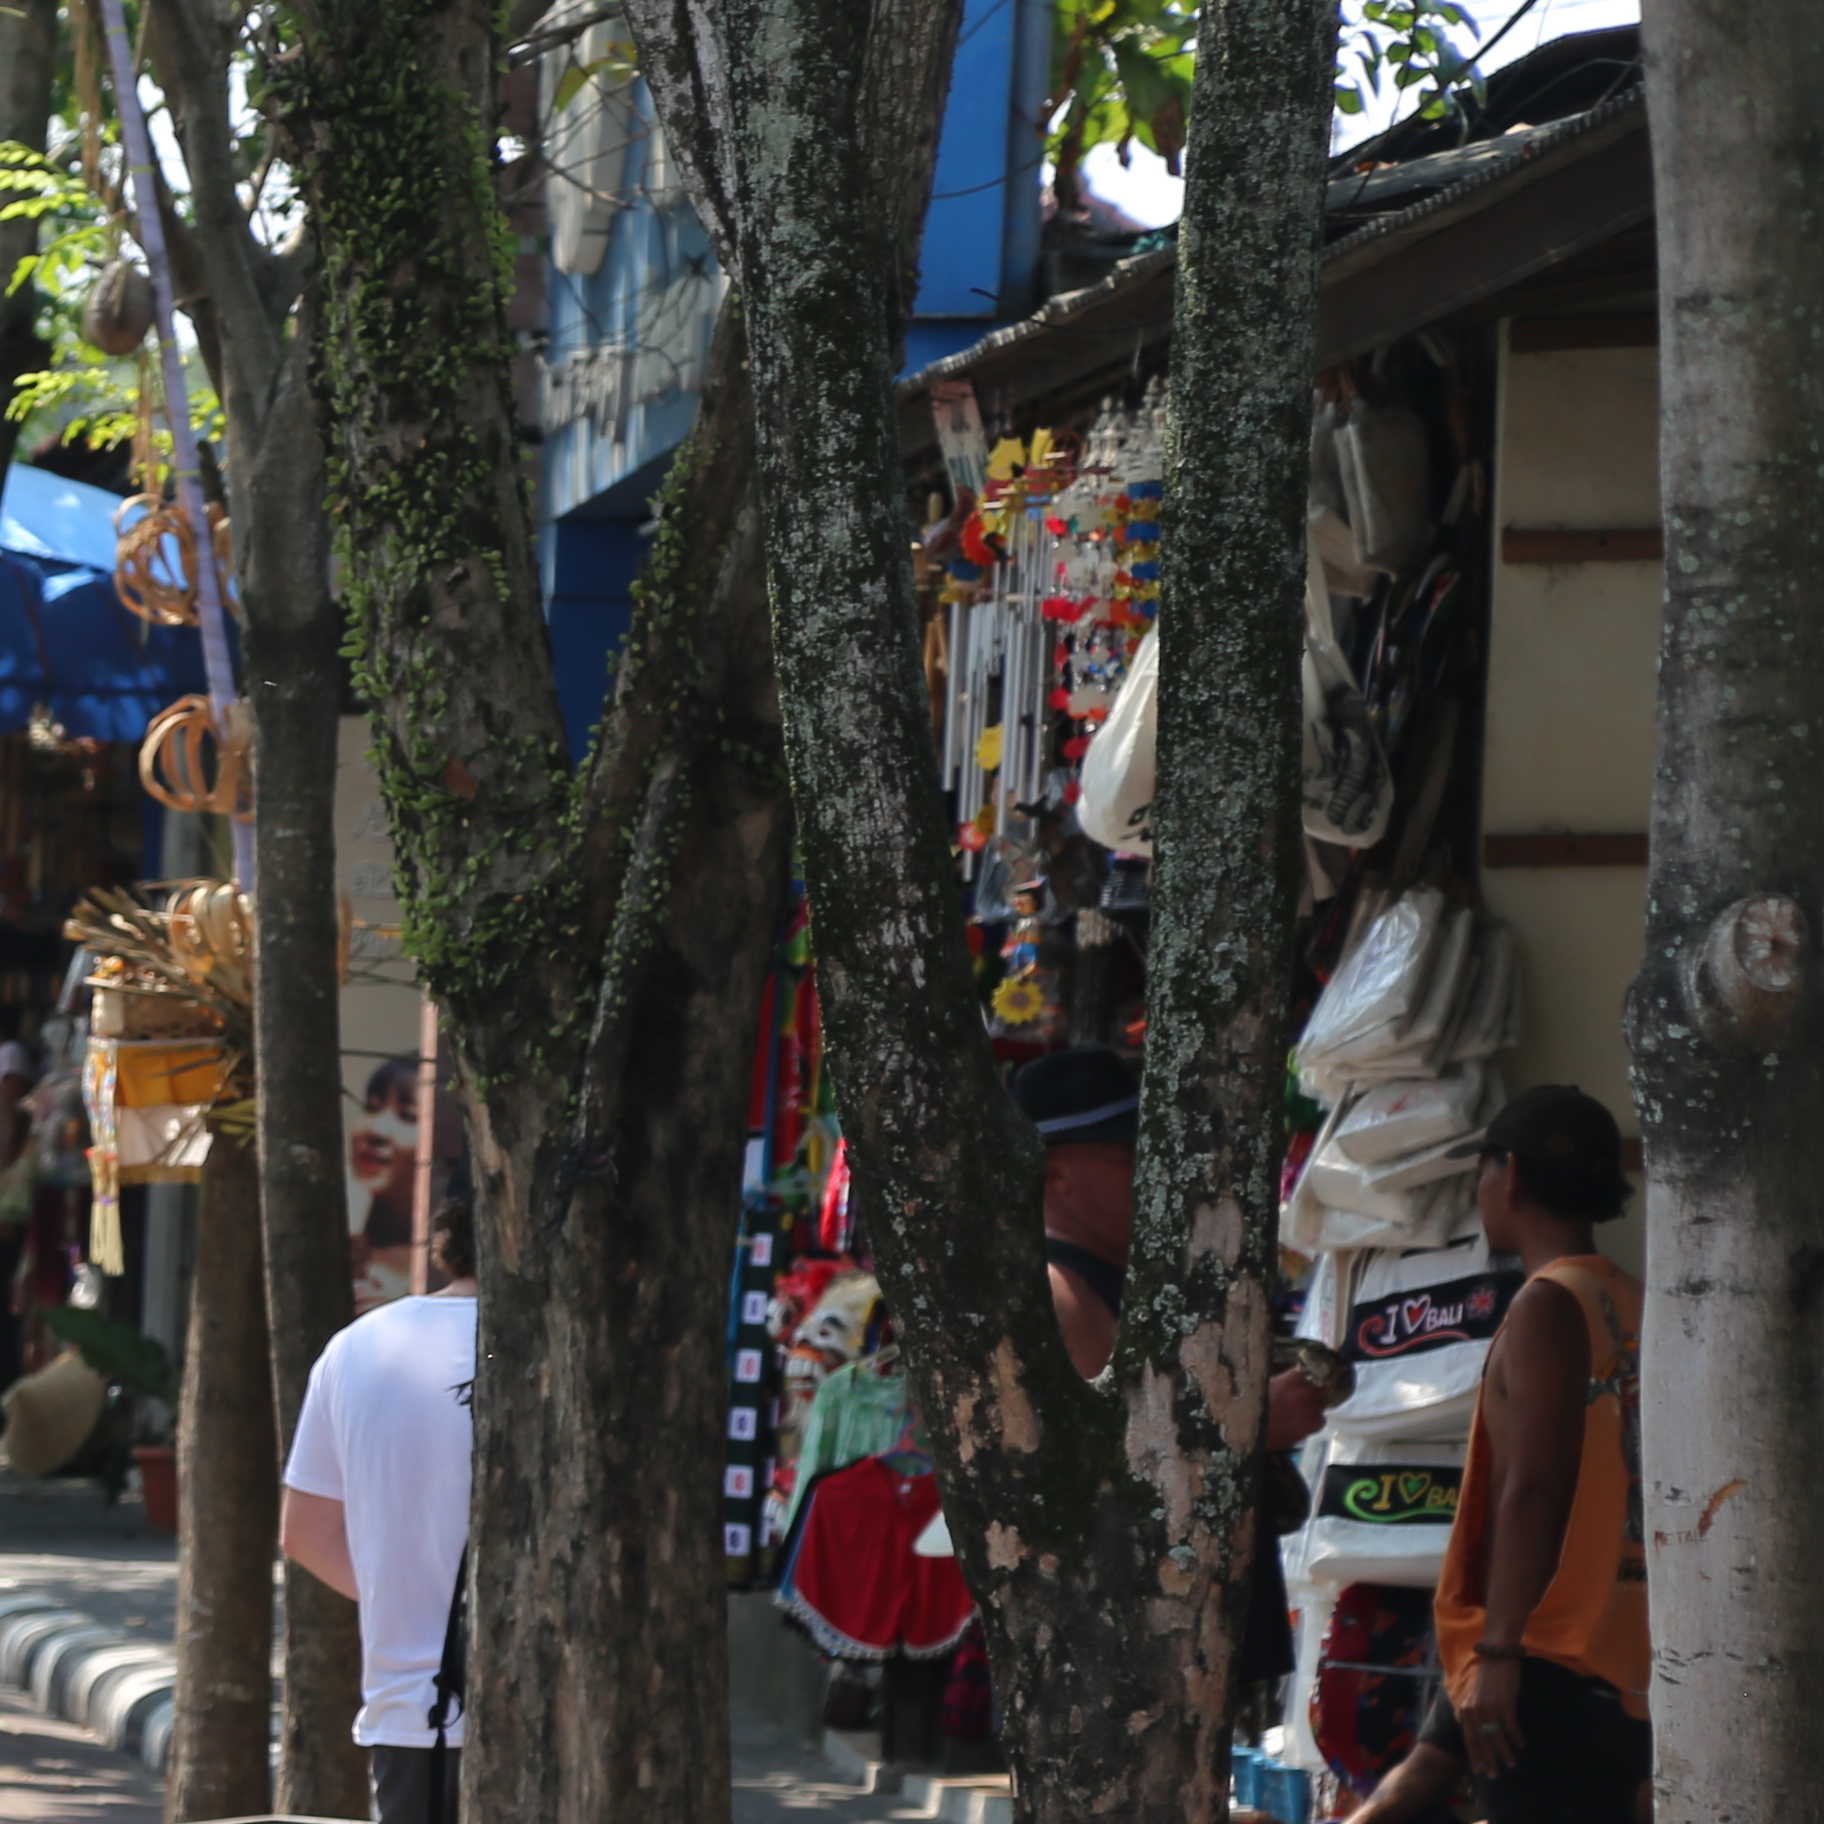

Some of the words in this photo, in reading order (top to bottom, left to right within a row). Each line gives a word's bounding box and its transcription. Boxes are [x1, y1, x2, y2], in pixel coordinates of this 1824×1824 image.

[1379, 1305, 1399, 1344] I
[1426, 1303, 1463, 1331] BALI
[1372, 1475, 1396, 1510] I
[1426, 1486, 1458, 1508] BA
